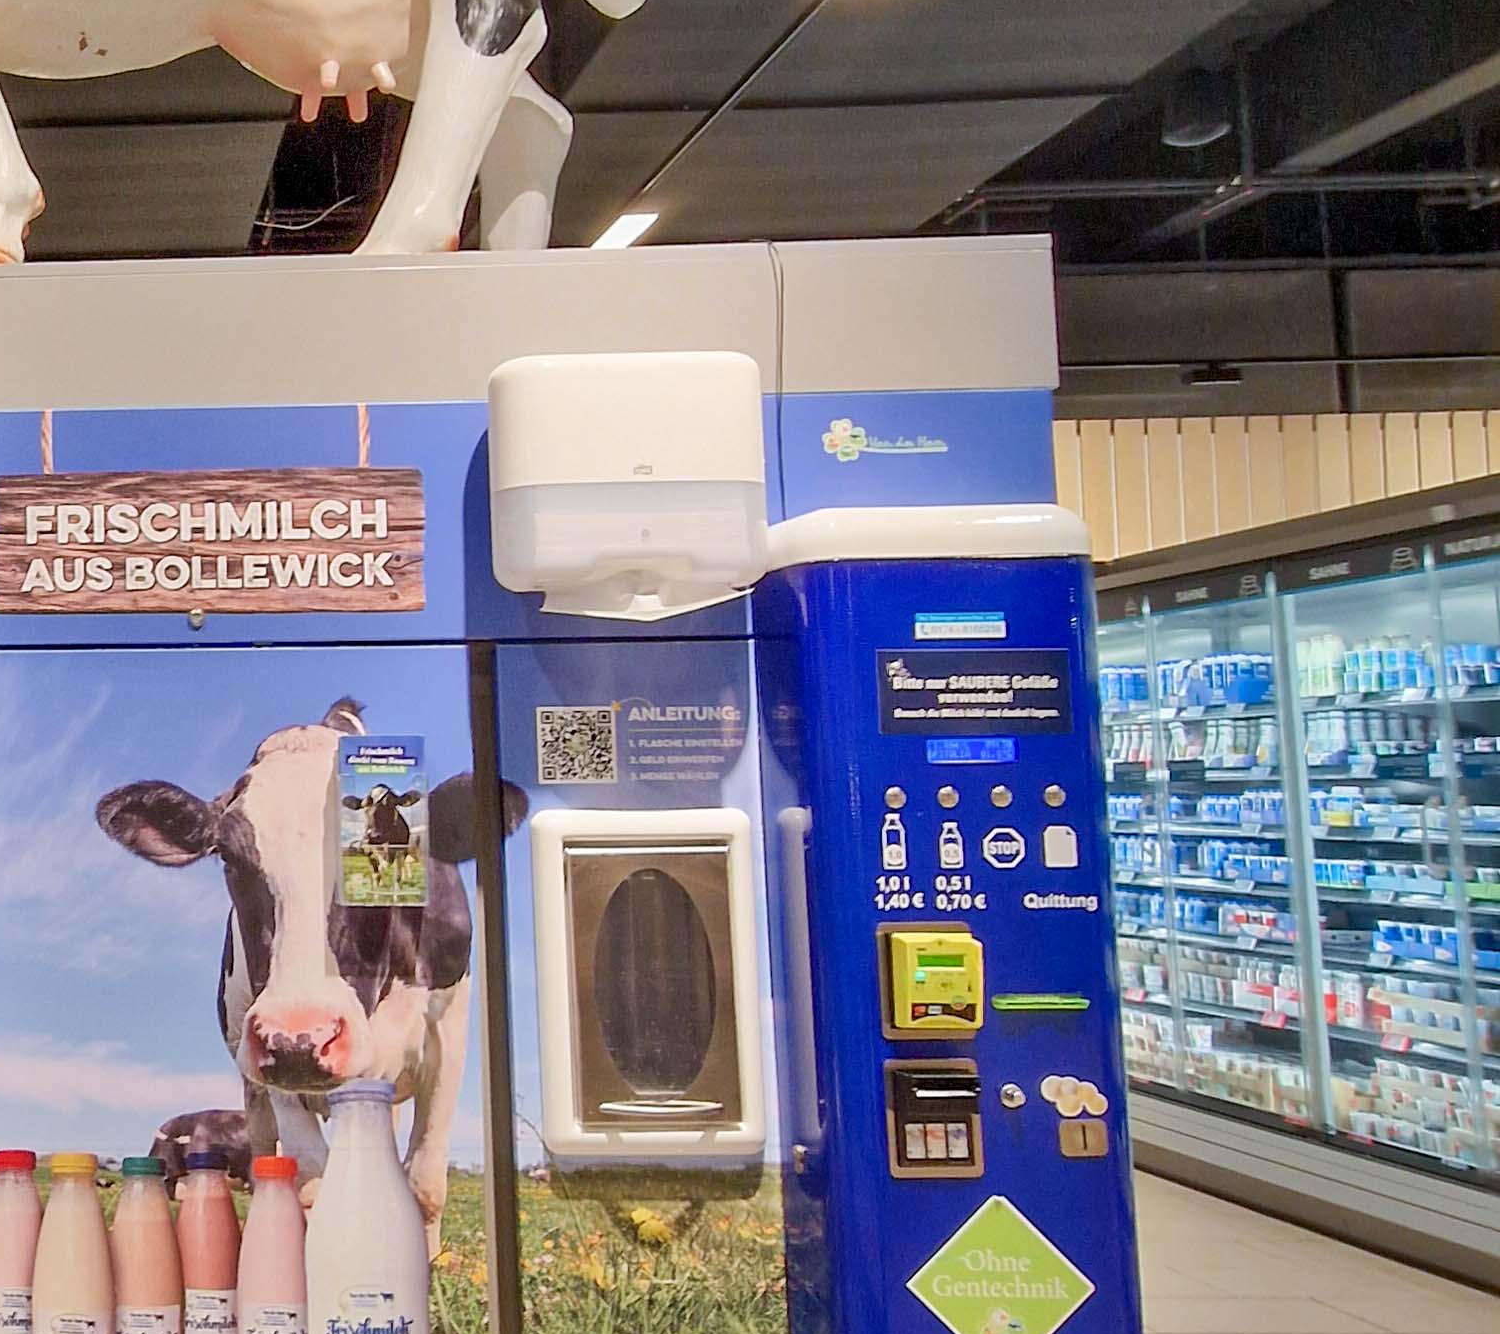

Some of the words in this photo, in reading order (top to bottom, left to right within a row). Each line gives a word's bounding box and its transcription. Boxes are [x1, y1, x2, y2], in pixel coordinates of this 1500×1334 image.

[25, 499, 388, 545] FRISCHMILCH
[20, 556, 113, 593] AUS
[124, 552, 394, 591] BOLLEWICK
[948, 675, 1011, 690] SAUBERE
[628, 706, 741, 722] ANLEITUNG:
[988, 841, 1021, 855] STOP
[876, 876, 901, 892] 1,0
[935, 875, 962, 892] 0,5
[875, 894, 910, 911] 1,40
[912, 893, 925, 909] €
[935, 893, 972, 912] 0,70
[974, 893, 987, 910] €
[1023, 893, 1099, 912] Quittung
[959, 1249, 1030, 1272] Ohne
[932, 1275, 1068, 1298] Gentechnik
